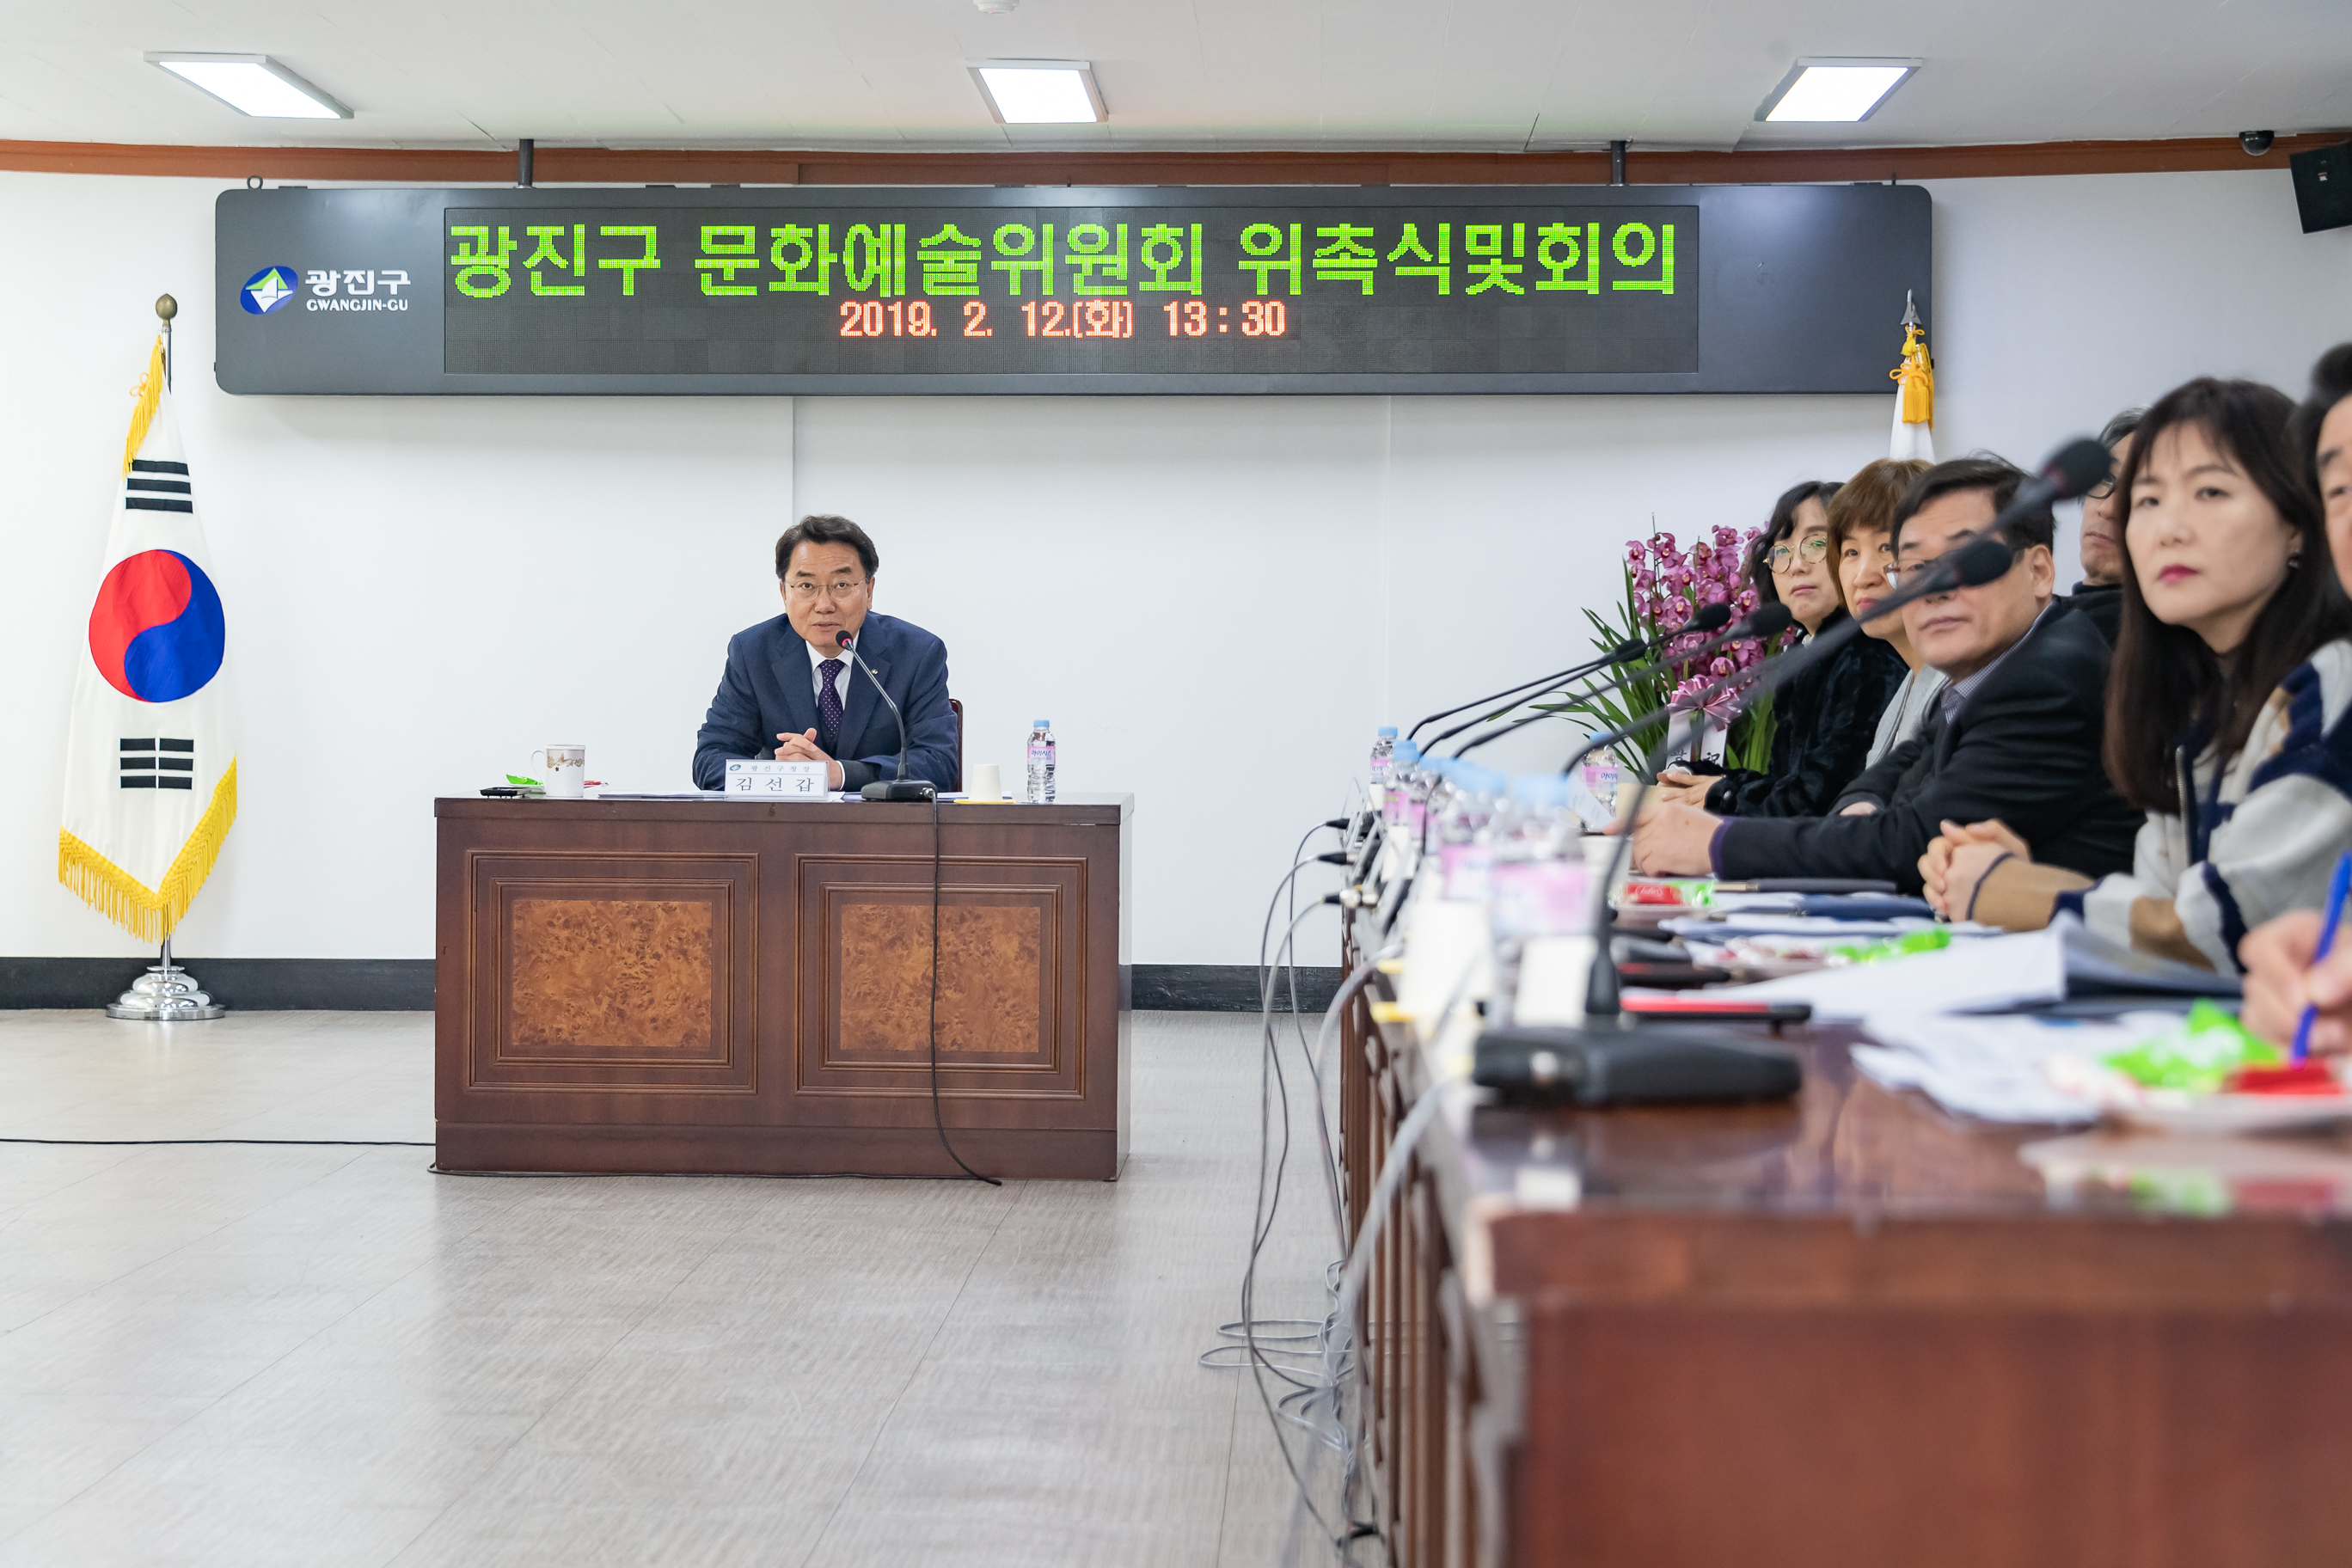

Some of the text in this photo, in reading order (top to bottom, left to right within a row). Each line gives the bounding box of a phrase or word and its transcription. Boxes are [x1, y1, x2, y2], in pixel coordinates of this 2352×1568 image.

[450, 222, 1675, 299] 광진구 문화예술위원회 위촉식및회의
[304, 269, 412, 297] 광진구
[306, 298, 408, 312] GWANGJIN-GU
[840, 299, 938, 338] 2019.
[963, 299, 994, 338] 2.
[736, 777, 814, 793] 김선갑
